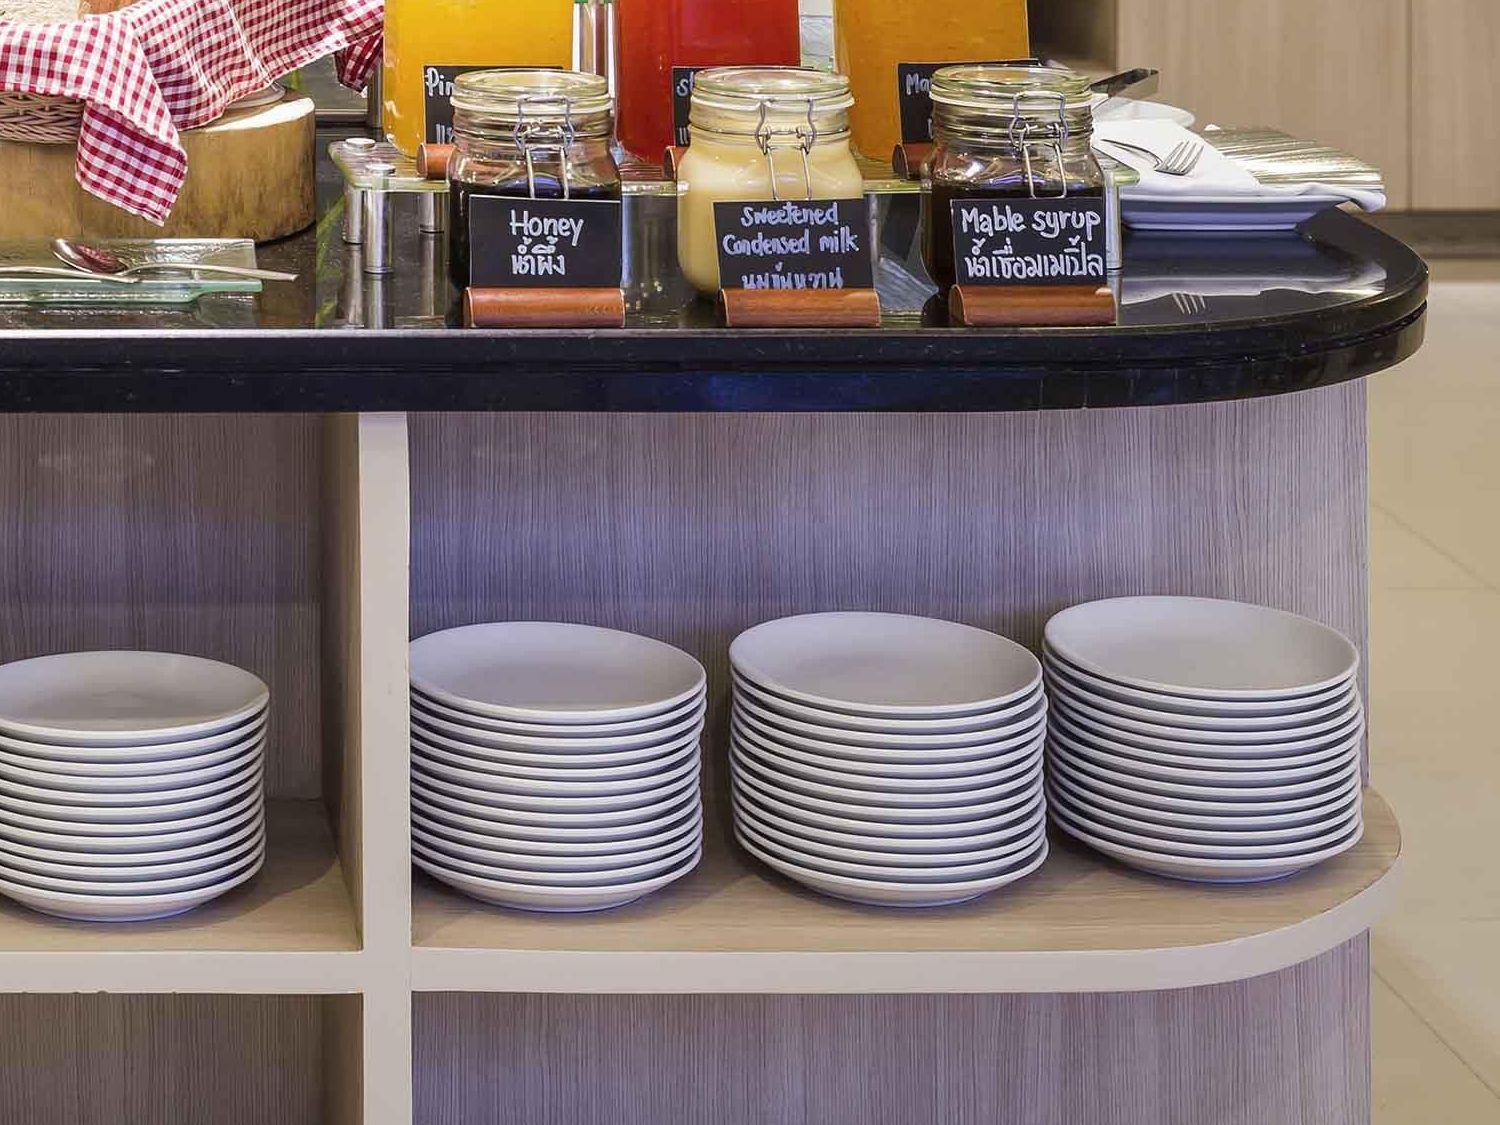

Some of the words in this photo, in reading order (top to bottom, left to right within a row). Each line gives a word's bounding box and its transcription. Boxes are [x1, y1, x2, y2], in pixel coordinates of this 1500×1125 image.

[509, 209, 584, 247] Honey
[740, 201, 839, 227] Sweetened
[961, 205, 1026, 237] Mable
[1031, 210, 1101, 241] syrup
[511, 235, 566, 275] น้ำผึ้ง
[722, 228, 810, 256] Condensed
[819, 226, 860, 254] milk
